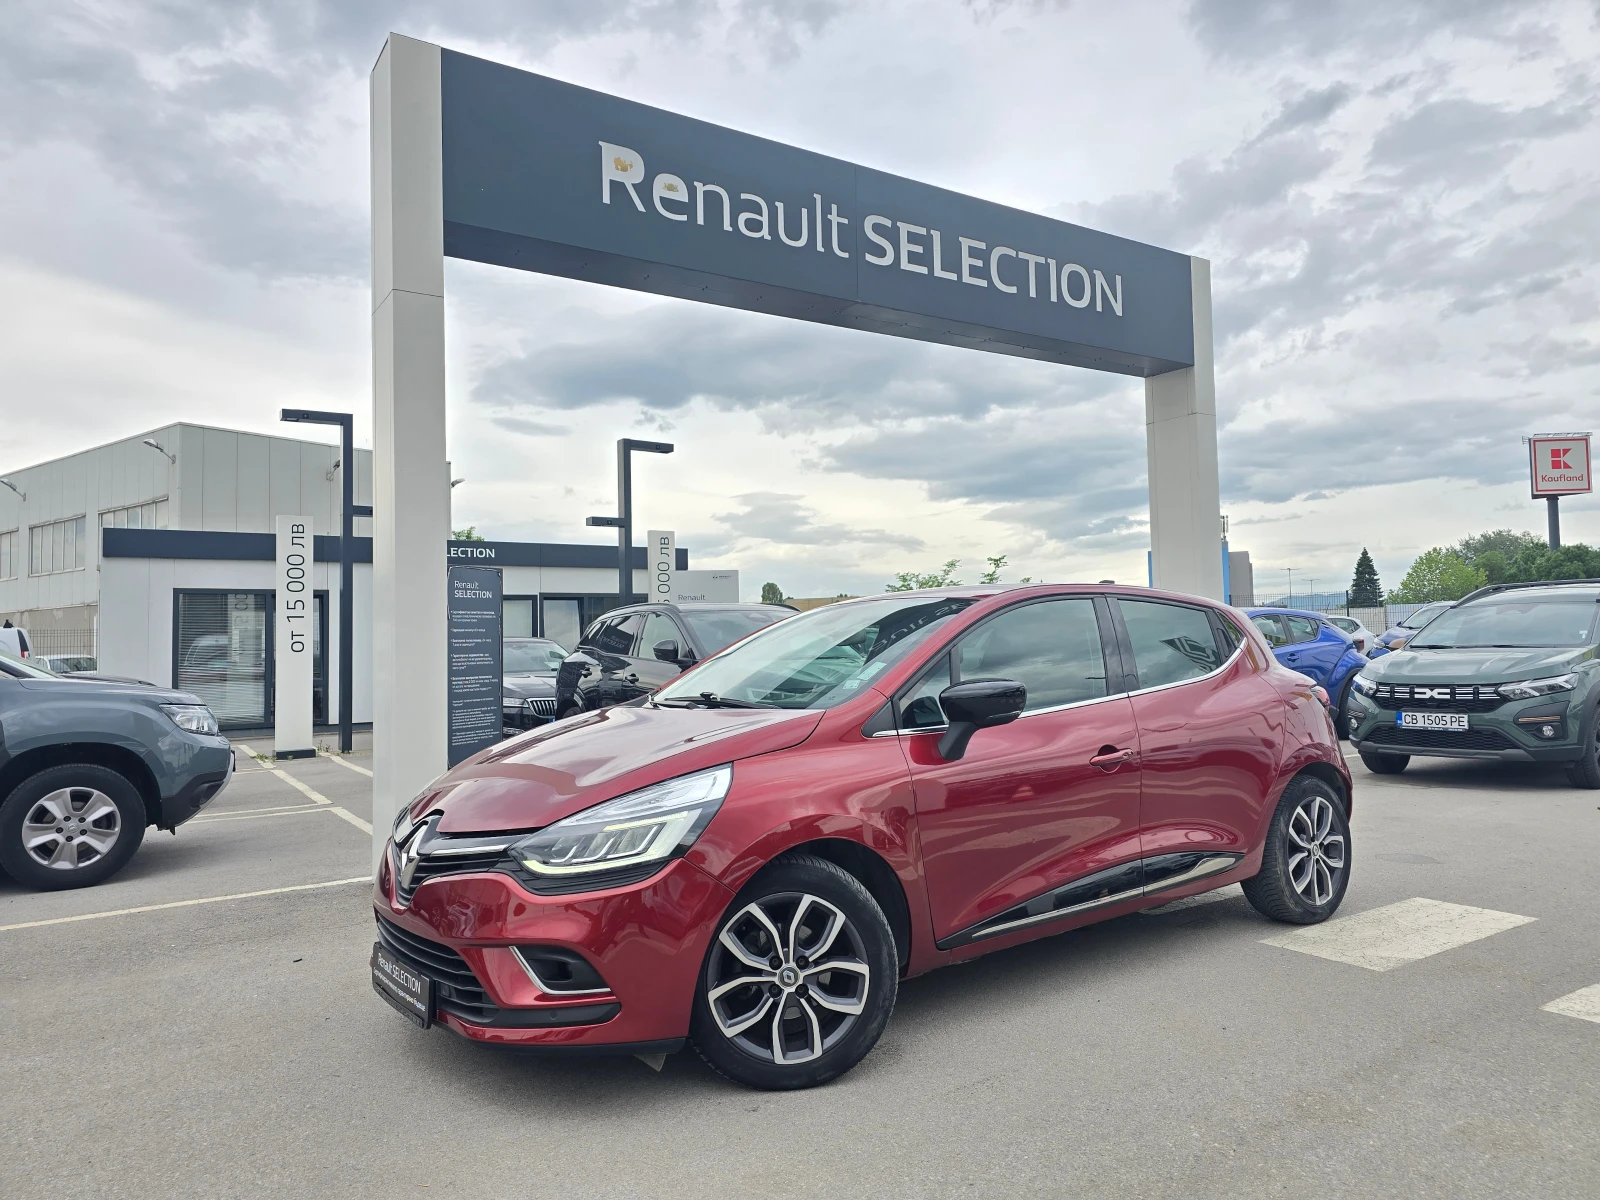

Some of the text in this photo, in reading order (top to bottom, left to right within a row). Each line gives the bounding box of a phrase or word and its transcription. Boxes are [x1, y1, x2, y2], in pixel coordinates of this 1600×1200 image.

[598, 140, 1123, 317] Renault SELECTION
[1541, 474, 1584, 482] Kaufland
[447, 547, 495, 558] ECTION
[286, 554, 305, 593] 000
[454, 590, 492, 599] SELECTION
[286, 599, 305, 623] 15
[1403, 713, 1418, 725] CB
[1421, 715, 1448, 726] 1505
[1450, 716, 1466, 727] PE
[392, 964, 421, 995] SELECTION
